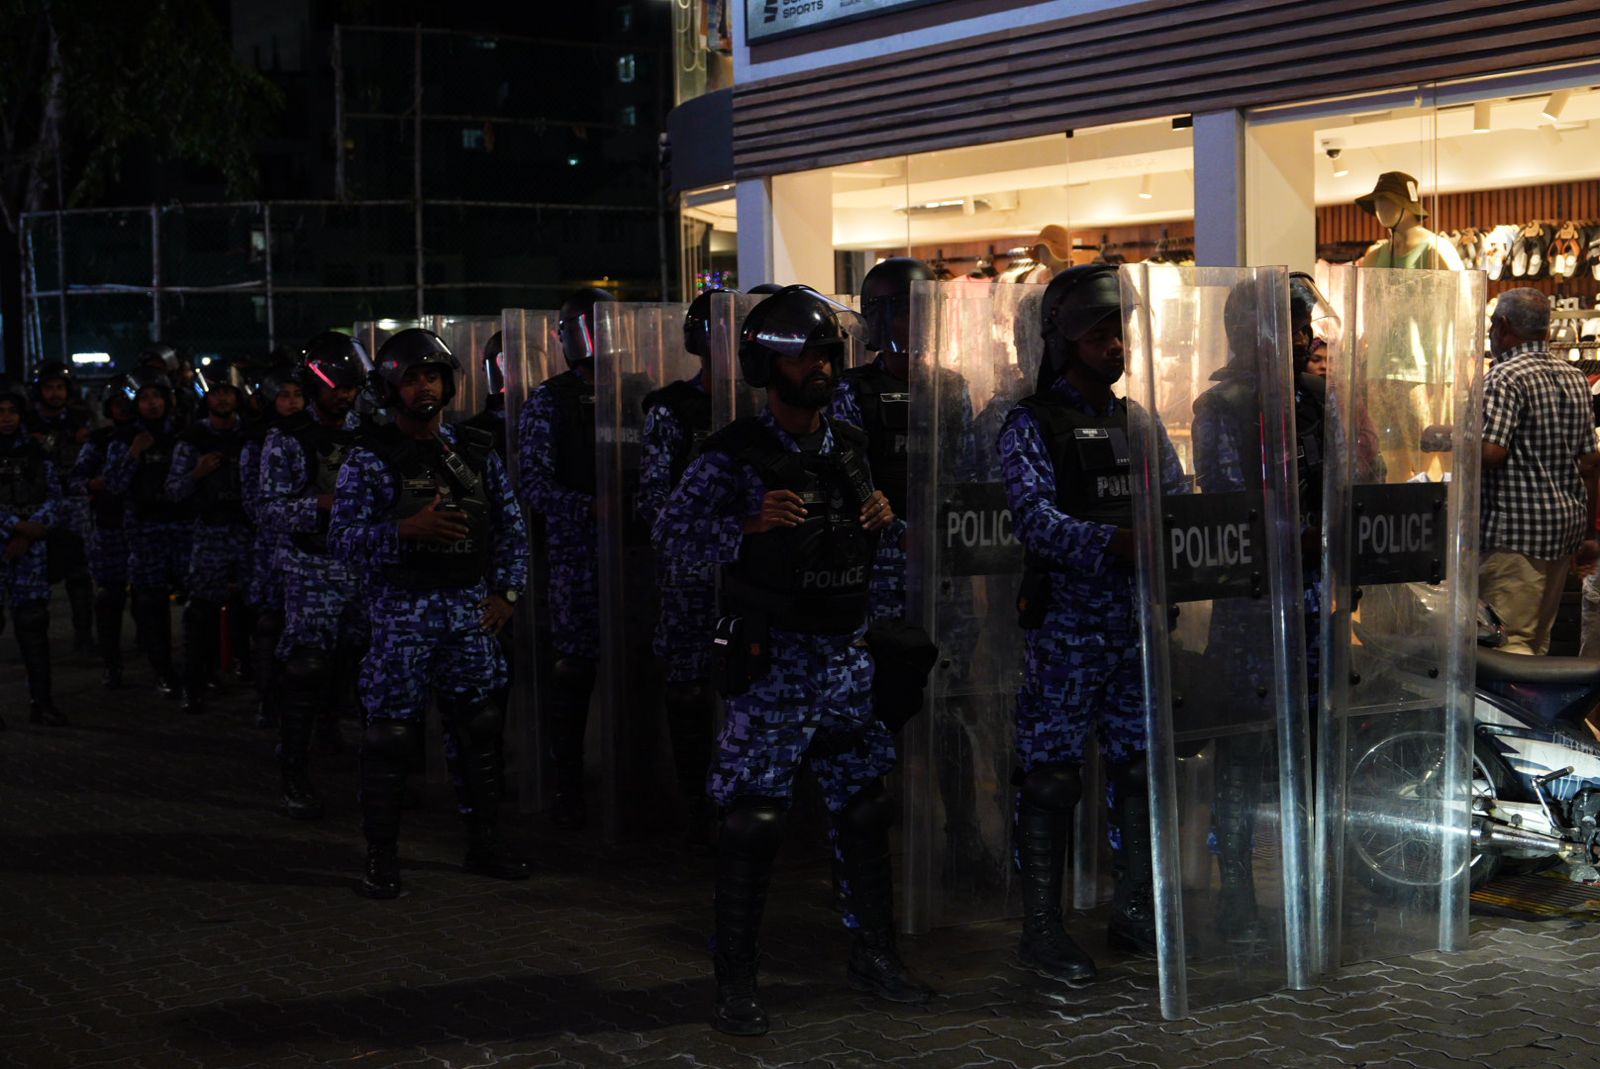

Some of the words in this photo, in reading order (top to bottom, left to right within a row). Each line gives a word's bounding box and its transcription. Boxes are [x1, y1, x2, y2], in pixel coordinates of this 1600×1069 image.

[782, 2, 824, 19] SPORTS
[947, 509, 1013, 548] POLIC
[1170, 523, 1253, 570] POLICE
[1357, 512, 1434, 555] POLICE
[802, 566, 865, 589] POLICE
